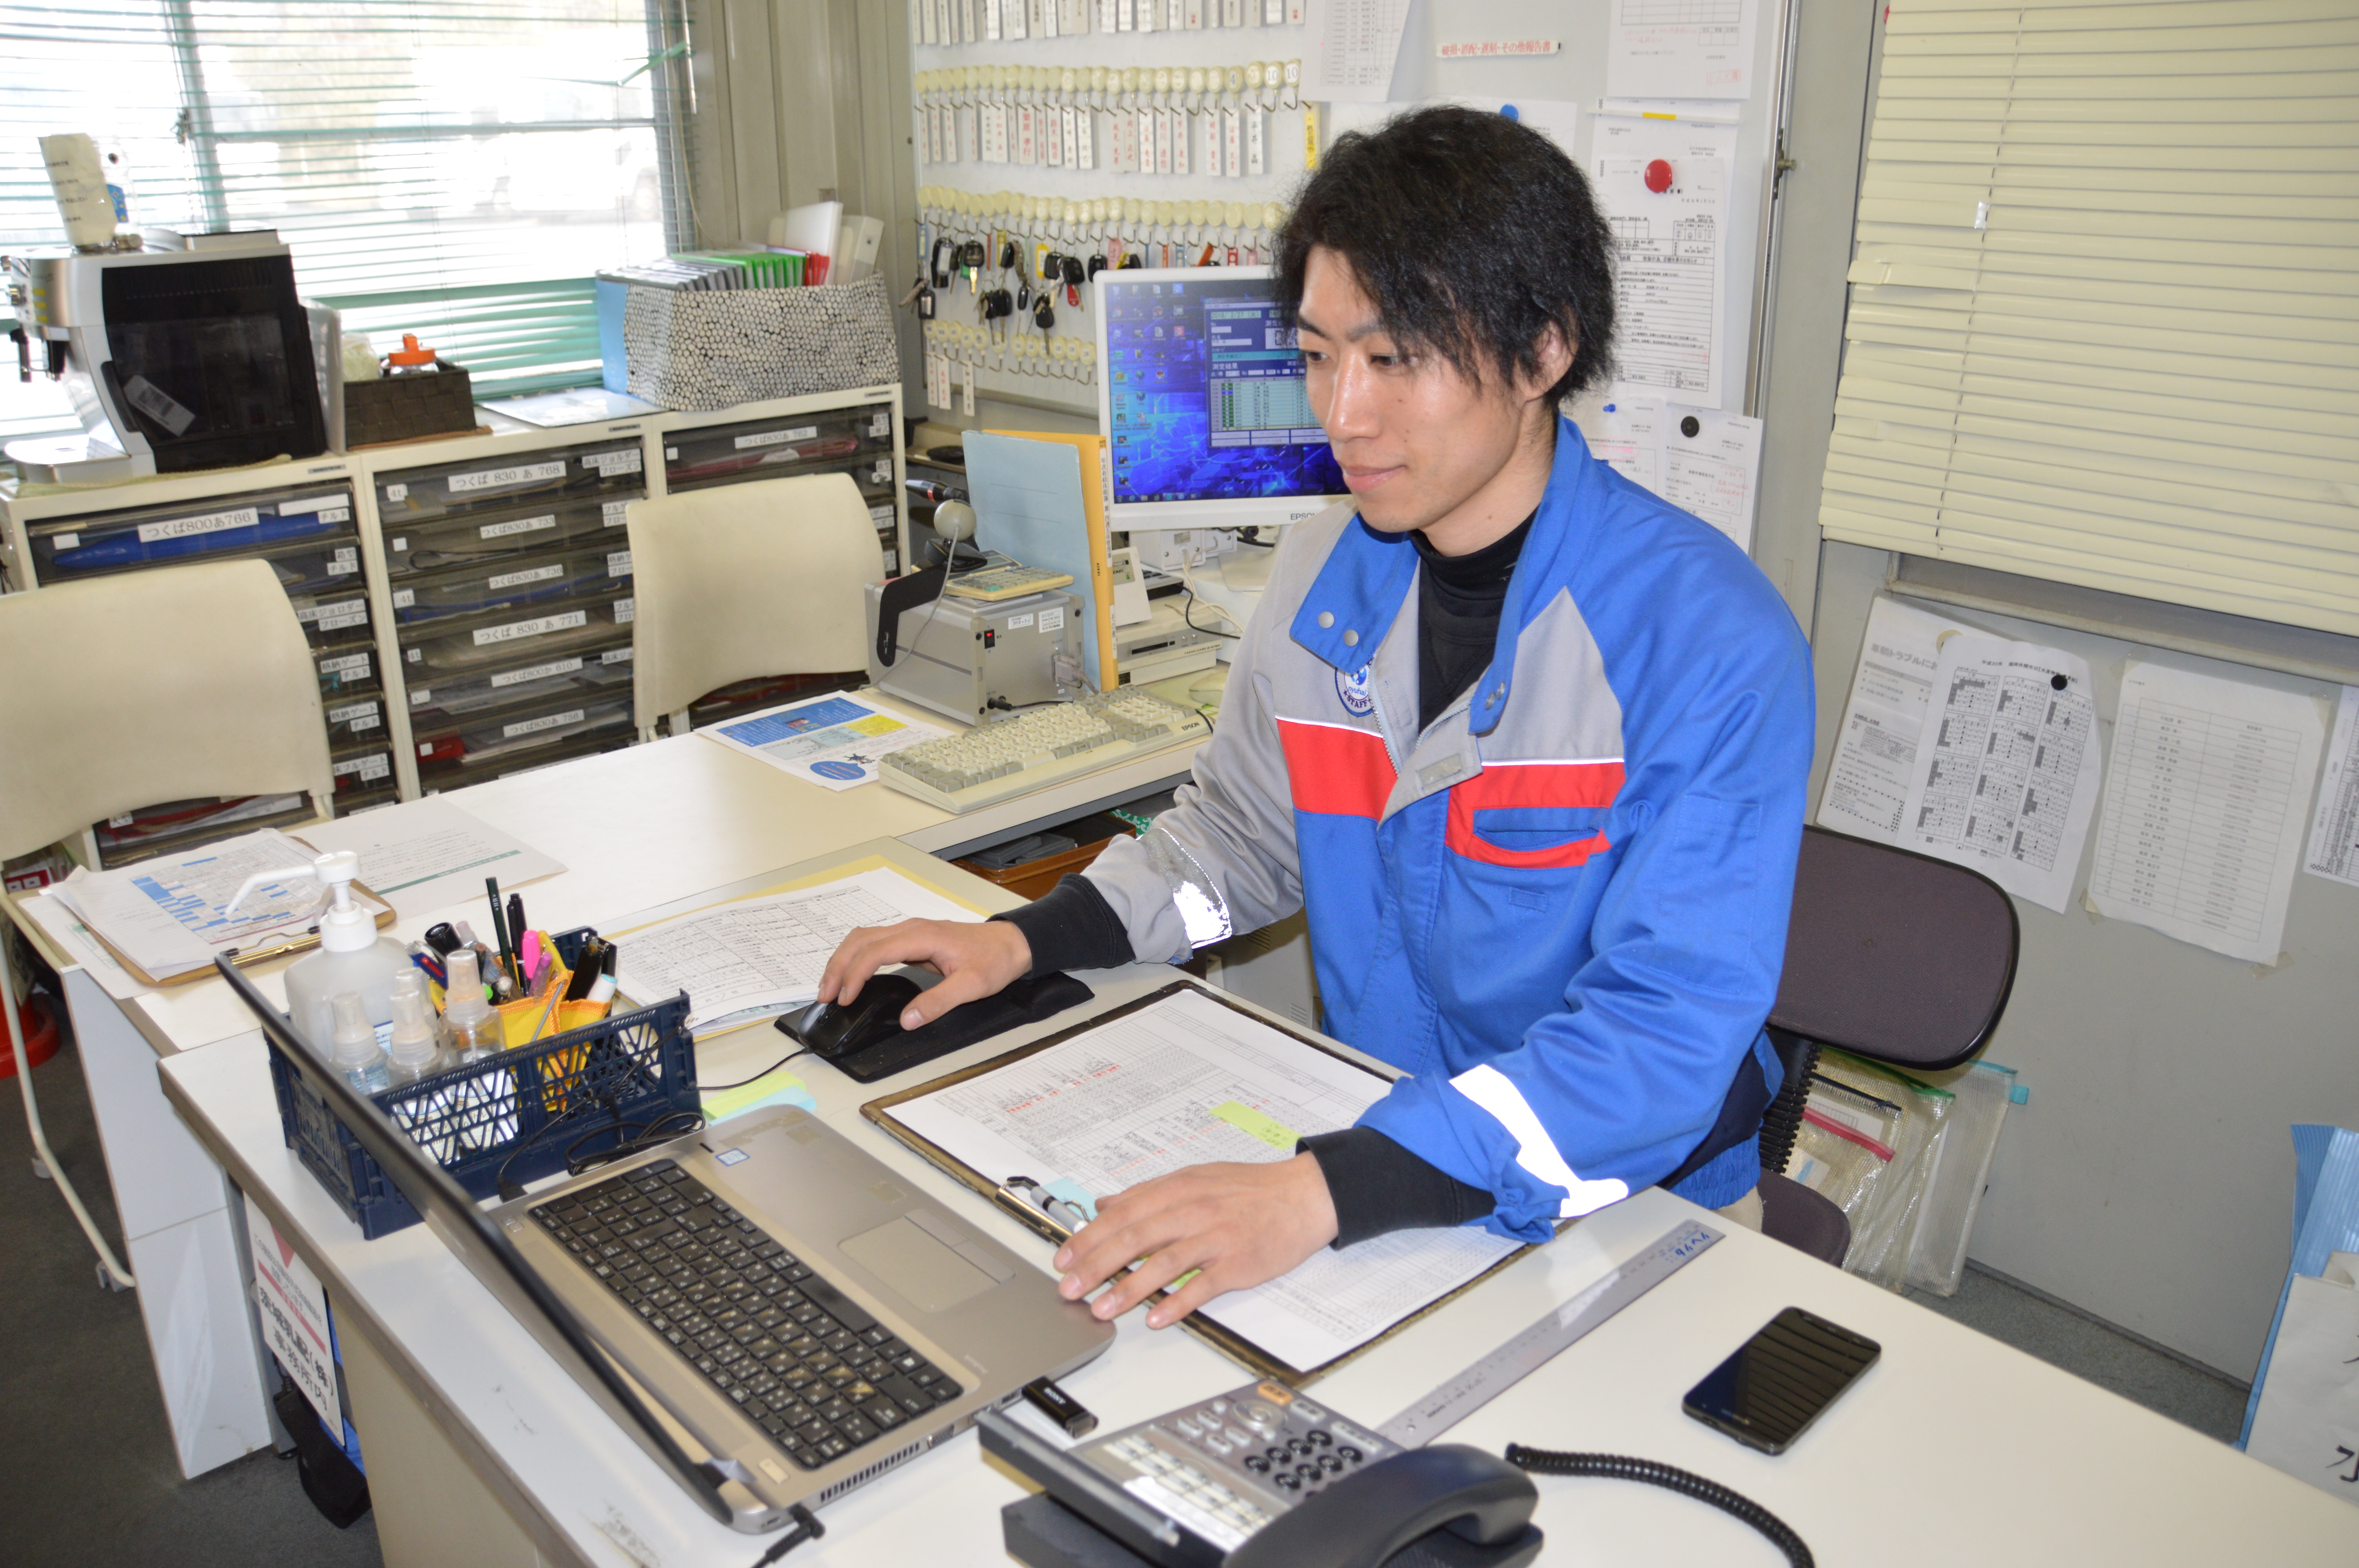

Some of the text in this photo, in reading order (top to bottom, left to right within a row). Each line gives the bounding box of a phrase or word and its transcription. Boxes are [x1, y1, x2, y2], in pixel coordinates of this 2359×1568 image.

[1267, 70, 1279, 81] 10
[1287, 67, 1298, 79] 10
[455, 464, 560, 487] つくば 830 あ 768
[320, 511, 349, 522] チルド
[146, 512, 252, 538] つくば800あ766
[482, 521, 533, 536] つくば830あ
[480, 614, 580, 642] つくば 830 あ 771
[1348, 686, 1367, 696] nyuhai
[1347, 695, 1368, 708] STAFF
[1181, 722, 1200, 731] EPSON
[272, 1324, 327, 1412] 事務所内
[1044, 1387, 1066, 1404] SONY
